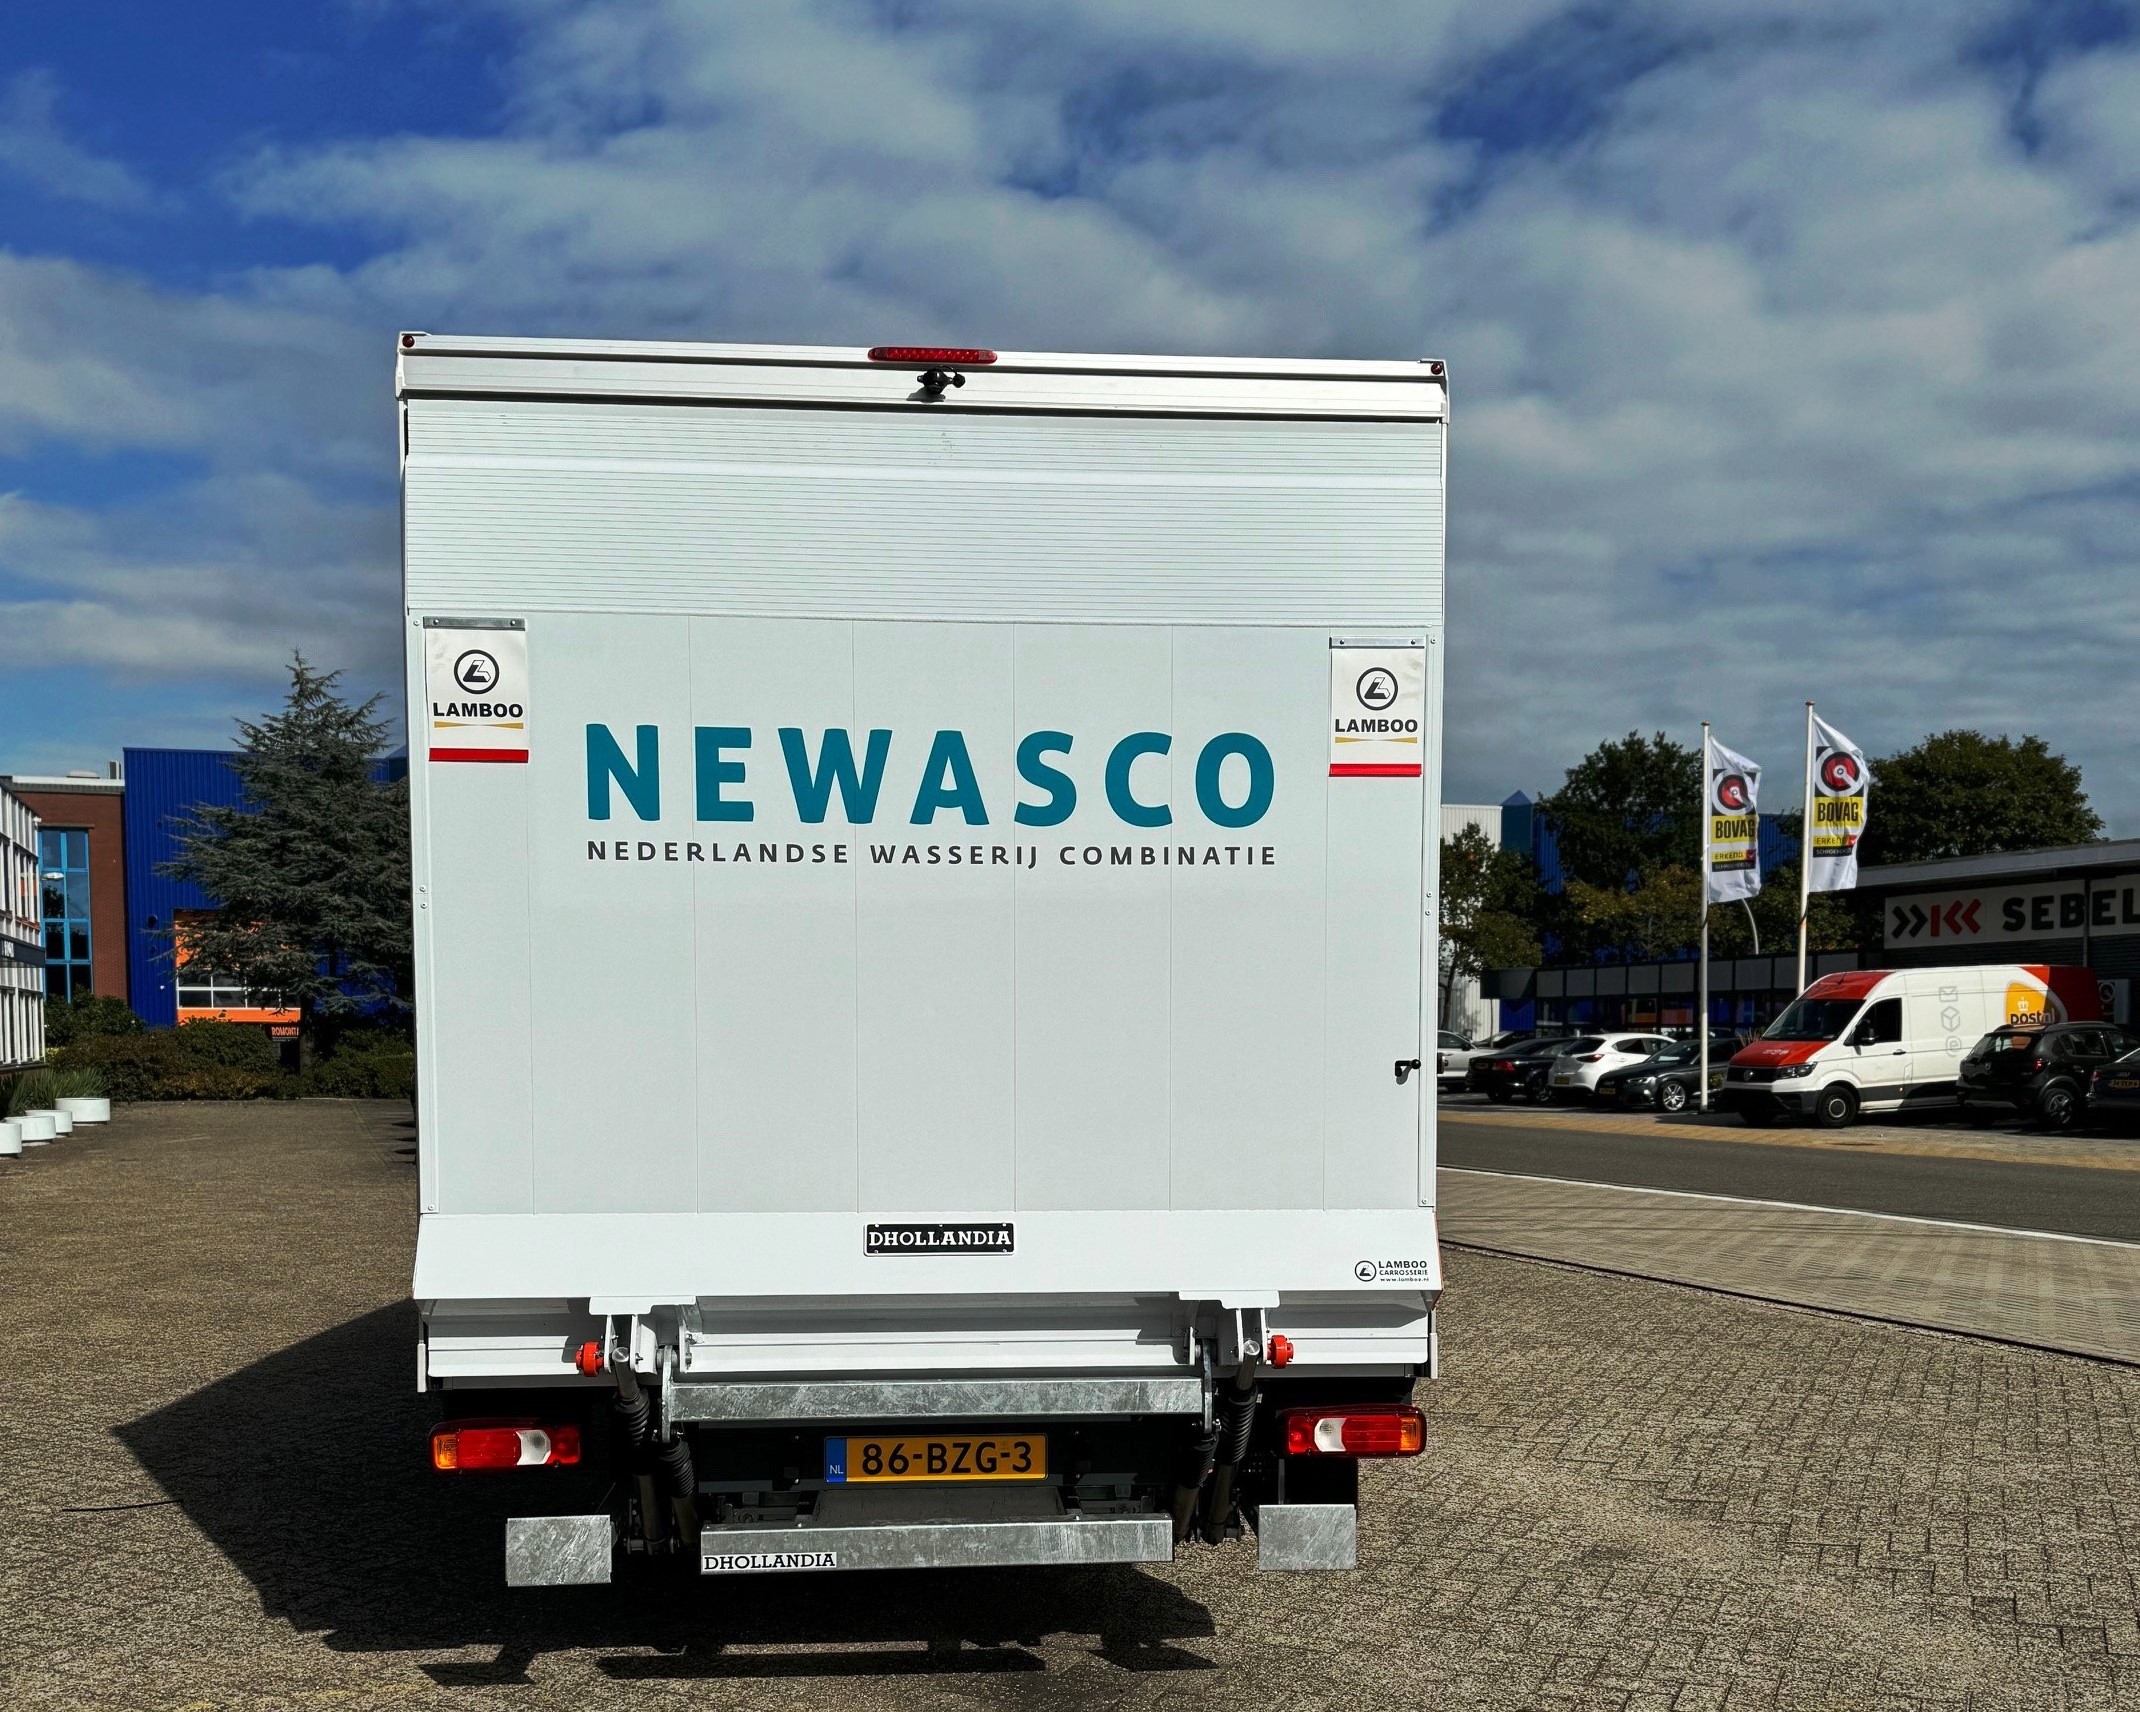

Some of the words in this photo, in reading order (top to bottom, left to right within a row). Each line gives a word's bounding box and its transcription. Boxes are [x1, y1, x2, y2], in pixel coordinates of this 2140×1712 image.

[433, 702, 524, 718] LAMBOO
[1334, 718, 1418, 733] LAMBOO
[585, 723, 1275, 828] NEWASCO
[1817, 801, 1859, 822] BOVAG
[1715, 819, 1756, 839] BOVAG
[587, 840, 848, 863] NEDERLANDSE
[869, 844, 1037, 870] WASSERIJ
[1059, 845, 1275, 866] COMBINATIE
[868, 1230, 1012, 1246] DHOLLANDIA
[861, 1441, 1033, 1476] 86-BZG-3
[829, 1464, 844, 1475] NL
[704, 1553, 836, 1570] DHOLLANDIA
